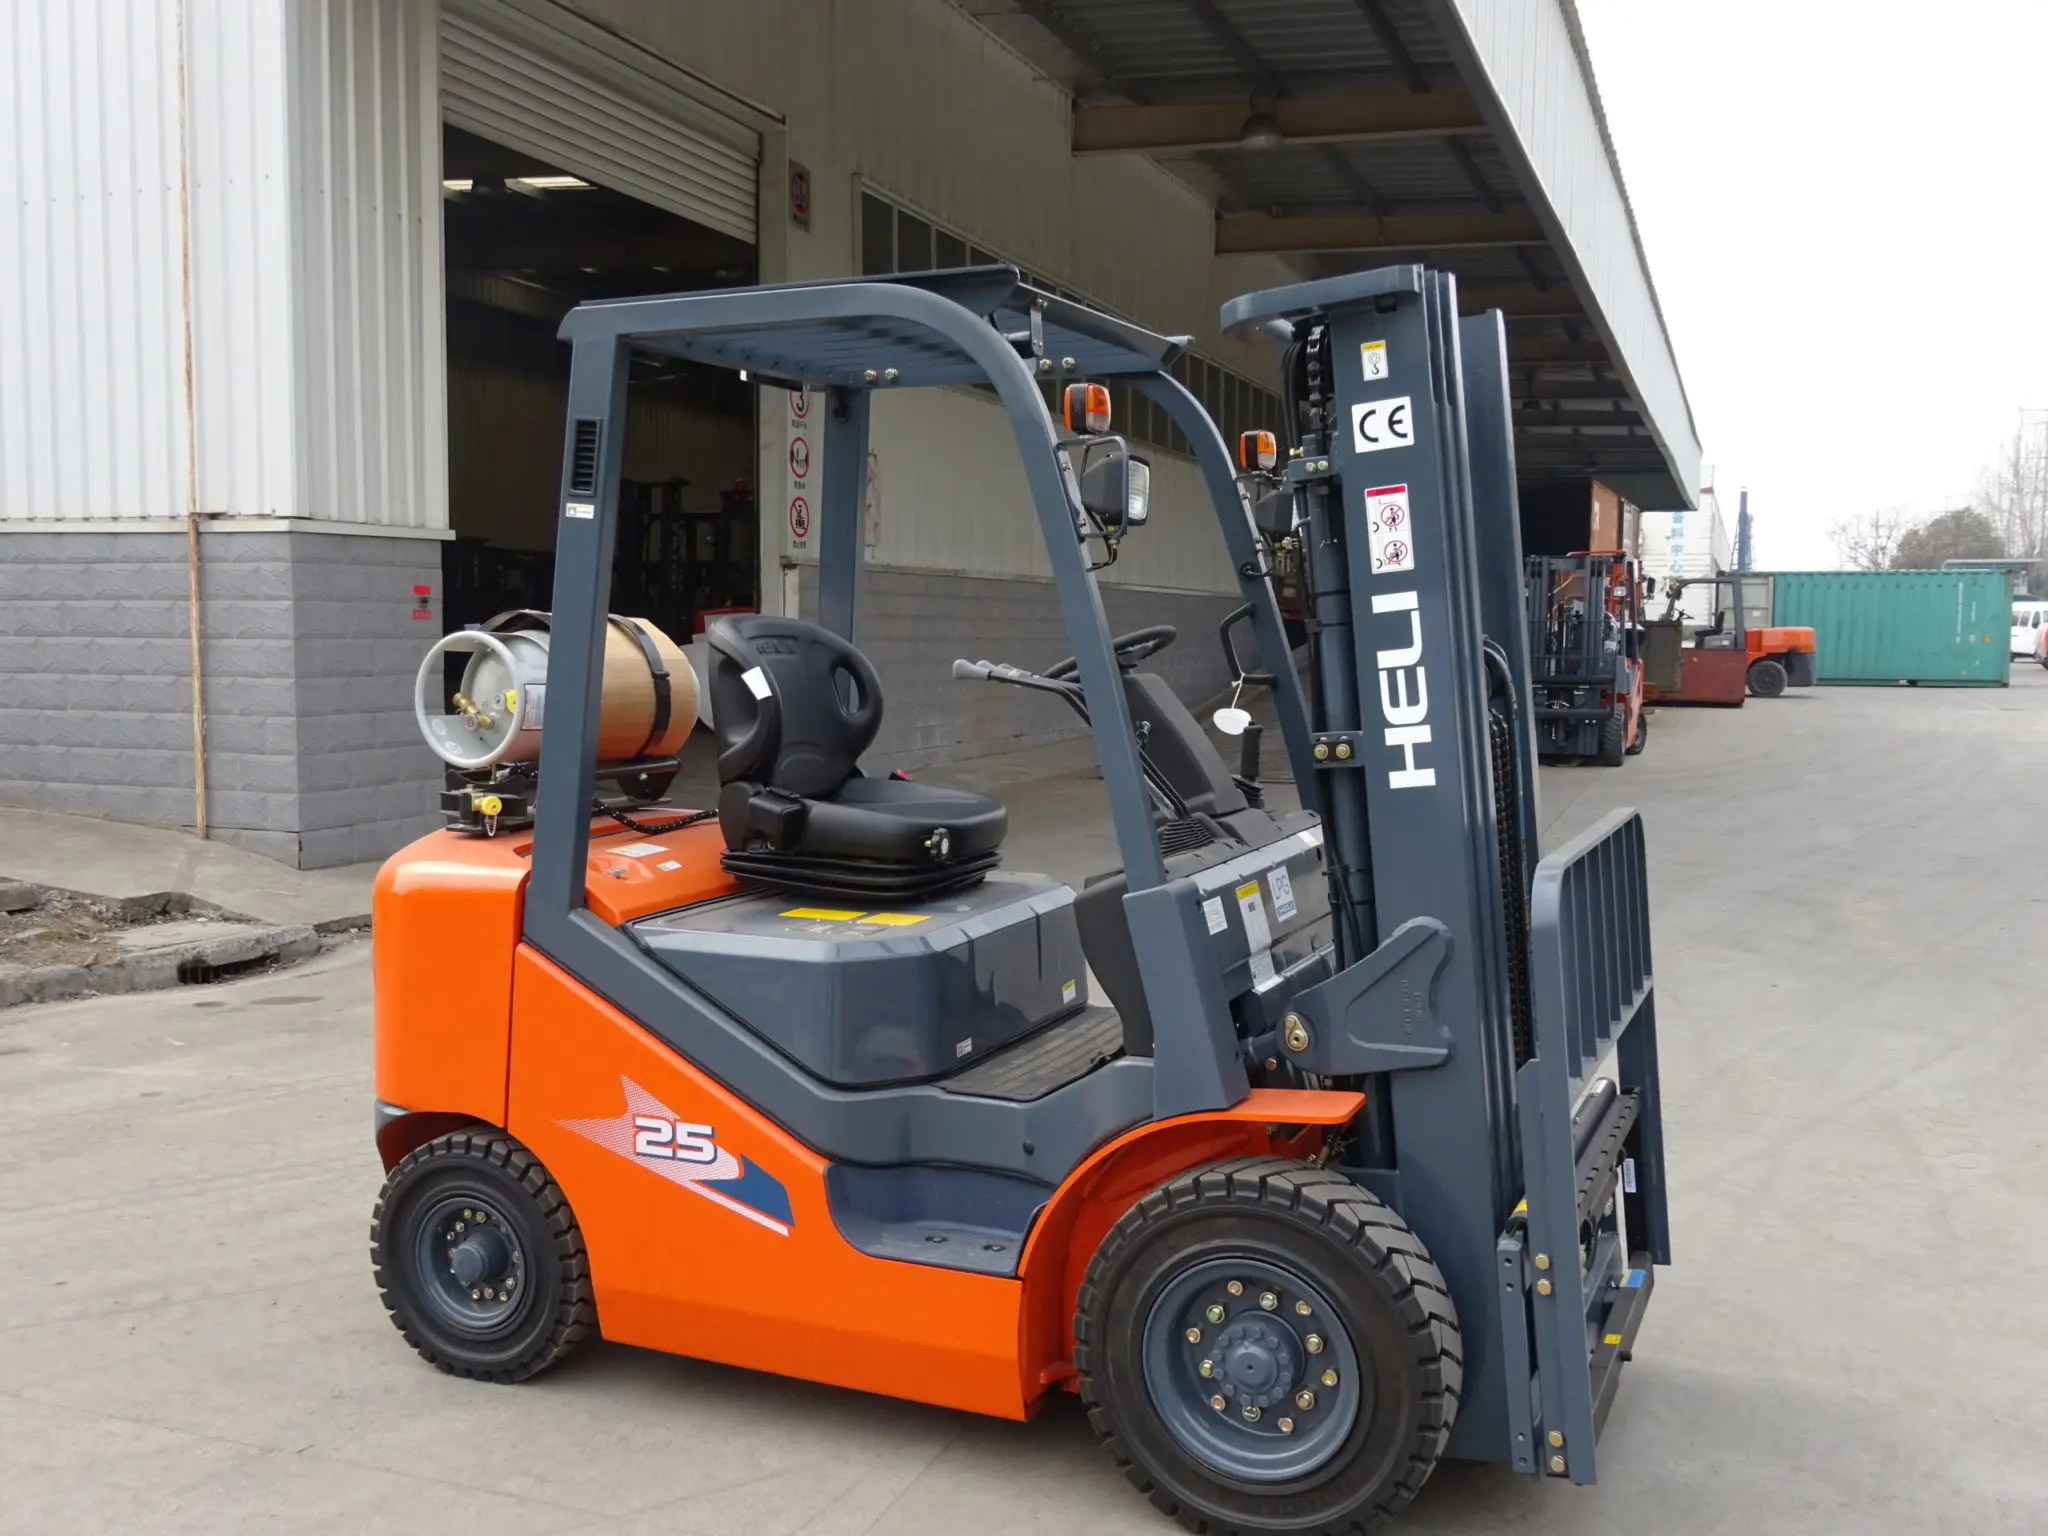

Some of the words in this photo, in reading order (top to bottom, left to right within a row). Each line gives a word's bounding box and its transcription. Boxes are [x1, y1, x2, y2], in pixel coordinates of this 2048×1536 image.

[1359, 404, 1408, 443] CE
[1371, 590, 1436, 789] HELI
[1271, 874, 1290, 900] LPG
[635, 1116, 717, 1165] 25
